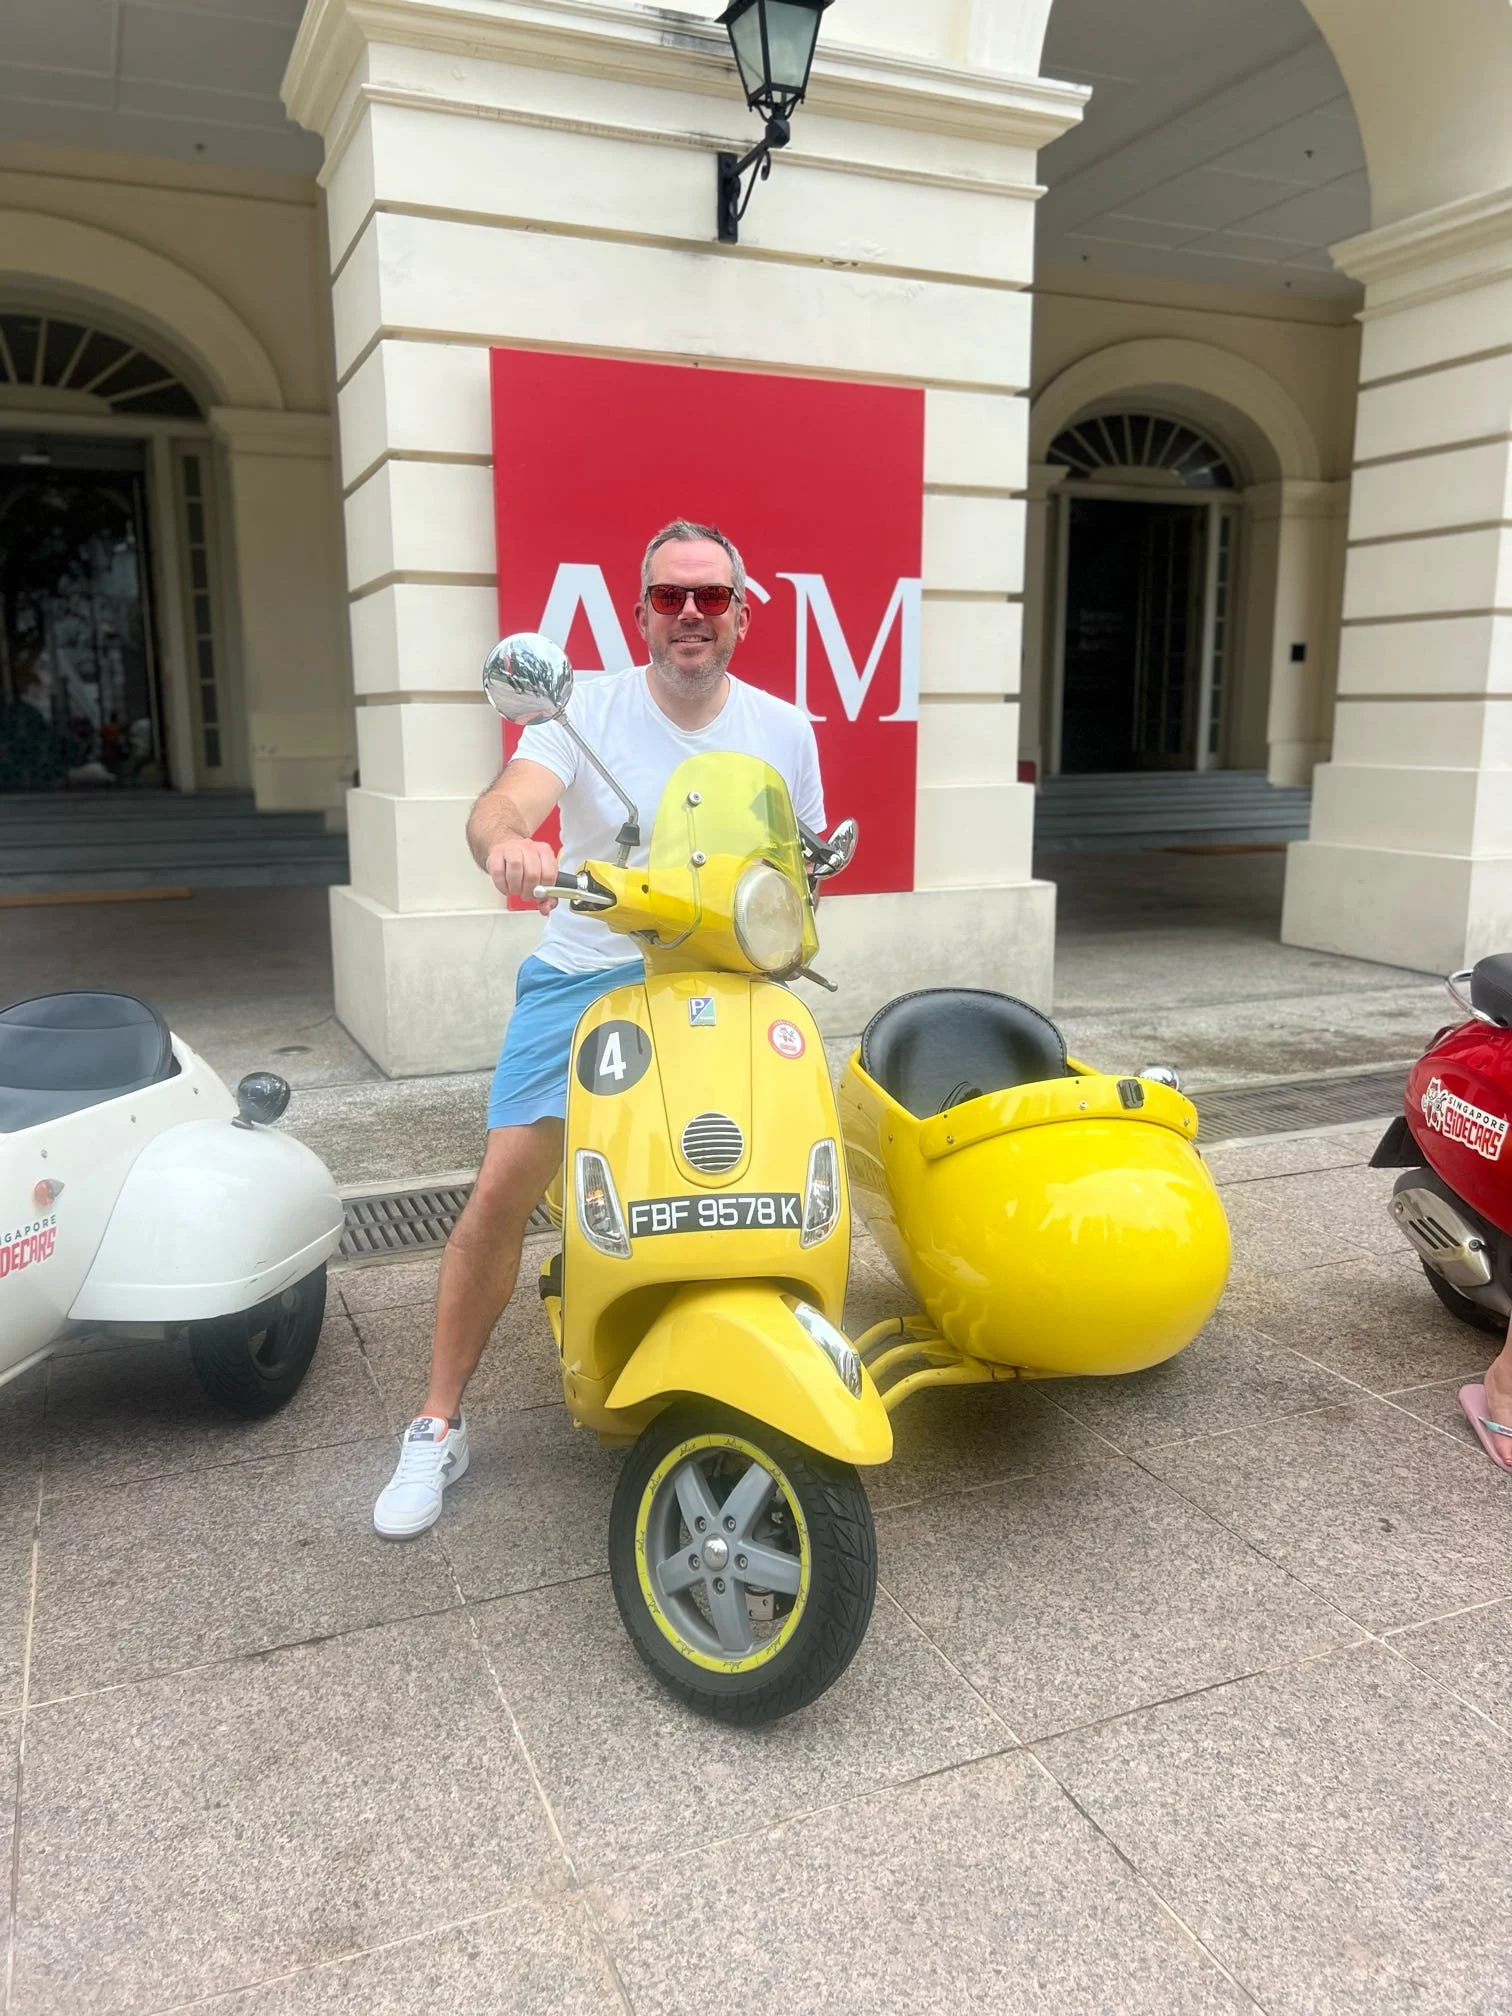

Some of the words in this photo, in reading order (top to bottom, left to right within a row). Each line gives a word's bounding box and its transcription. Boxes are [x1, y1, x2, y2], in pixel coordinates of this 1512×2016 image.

[537, 562, 921, 721] AM
[599, 1031, 626, 1081] 4
[1447, 1096, 1505, 1132] SINGAPORE
[631, 1200, 691, 1234] FBF
[697, 1196, 776, 1227] 9578
[781, 1197, 799, 1225] K
